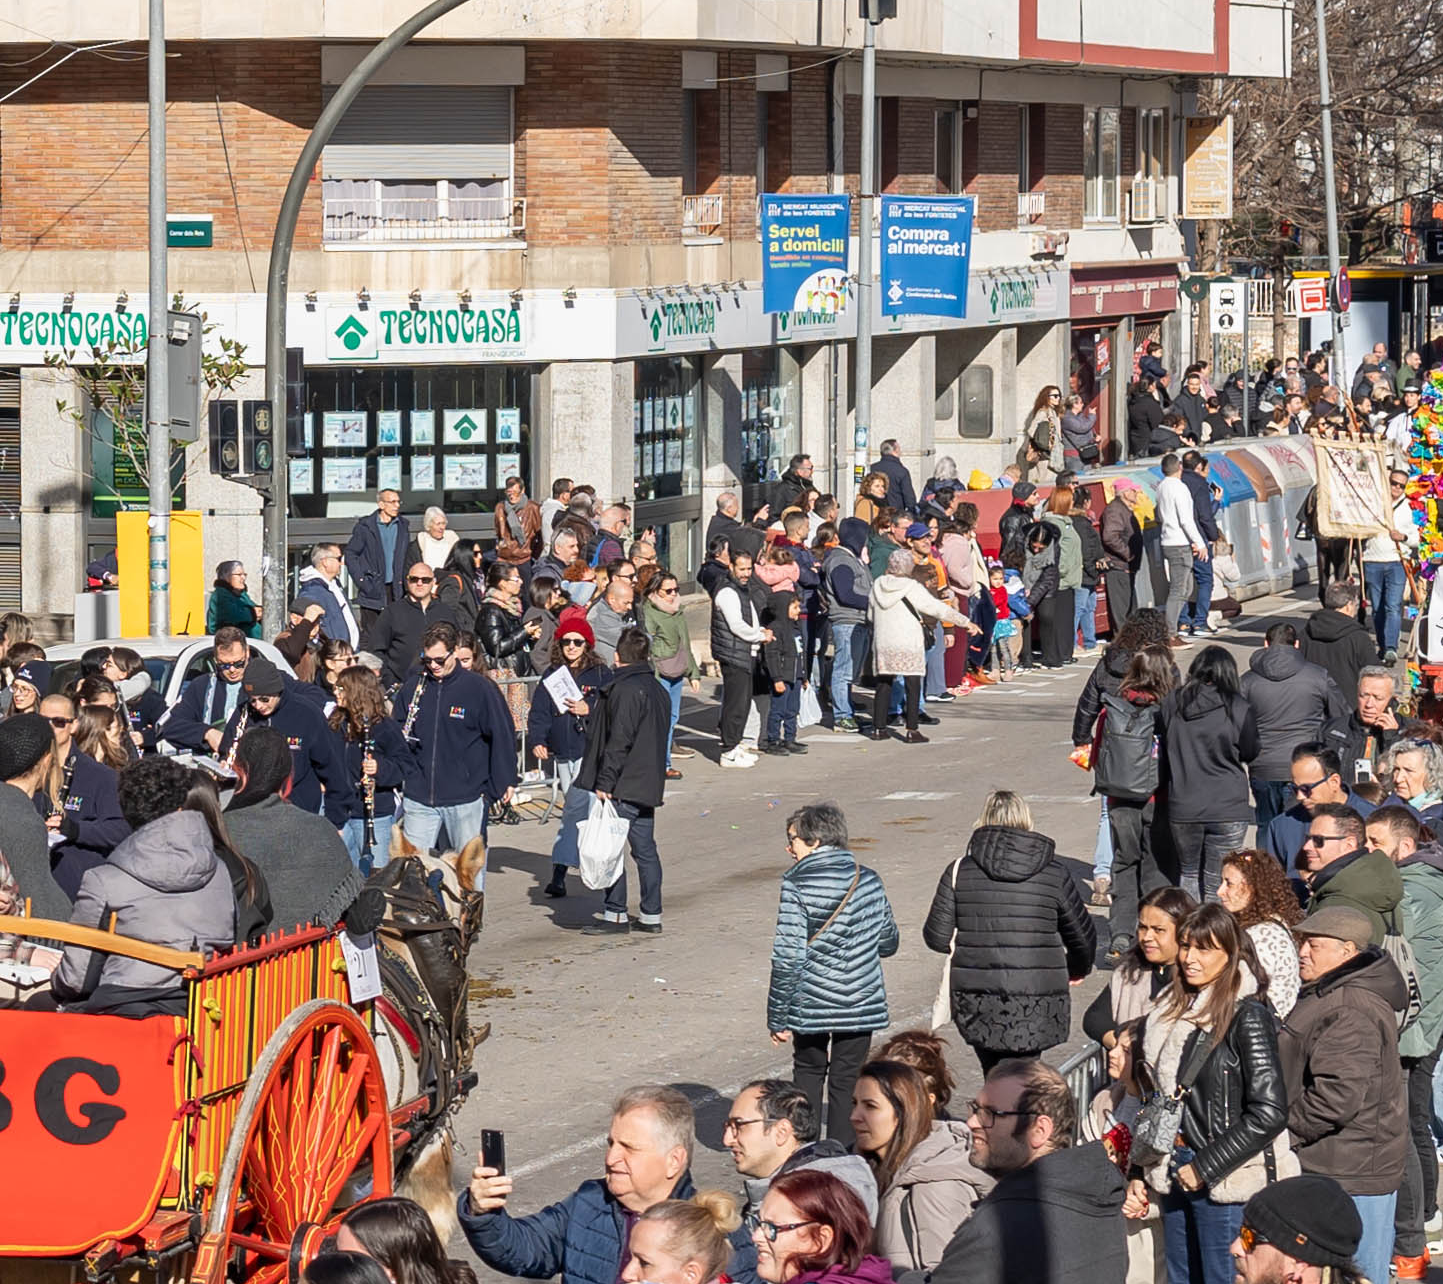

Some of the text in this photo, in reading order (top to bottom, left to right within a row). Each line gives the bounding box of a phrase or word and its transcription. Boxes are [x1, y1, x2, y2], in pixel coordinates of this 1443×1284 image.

[768, 224, 819, 238] Servei
[888, 226, 949, 243] Compra
[769, 238, 844, 253] a domicili
[888, 240, 966, 257] al mercat!
[0, 311, 147, 346] TECNOCASA
[380, 308, 521, 344] TECNOCASA
